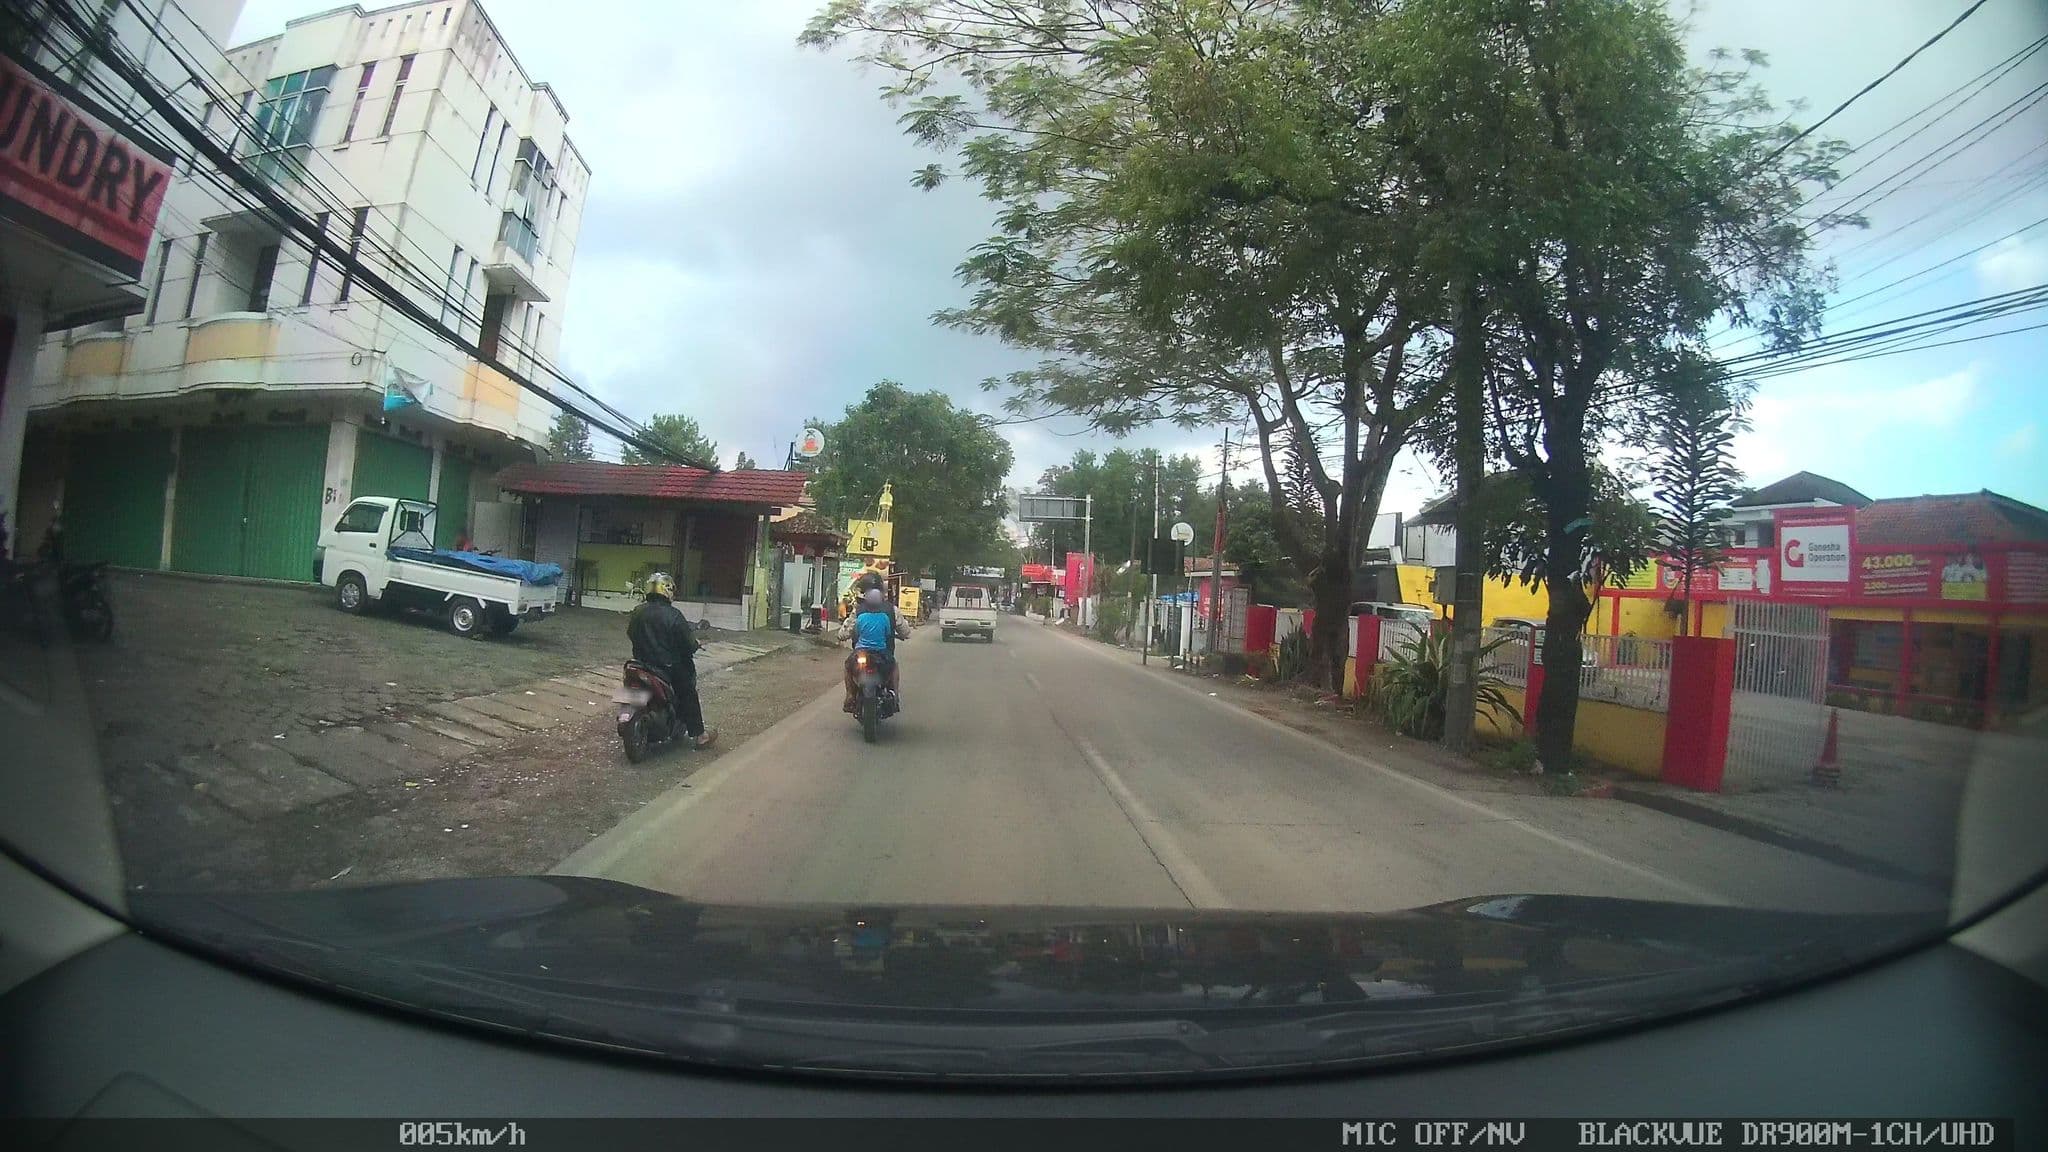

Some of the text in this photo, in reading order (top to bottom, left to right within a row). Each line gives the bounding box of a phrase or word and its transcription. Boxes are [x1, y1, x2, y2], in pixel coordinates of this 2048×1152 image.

[1808, 542, 1841, 551] Ganesha
[1808, 553, 1847, 562] Operation
[1862, 554, 1913, 570] 43.000
